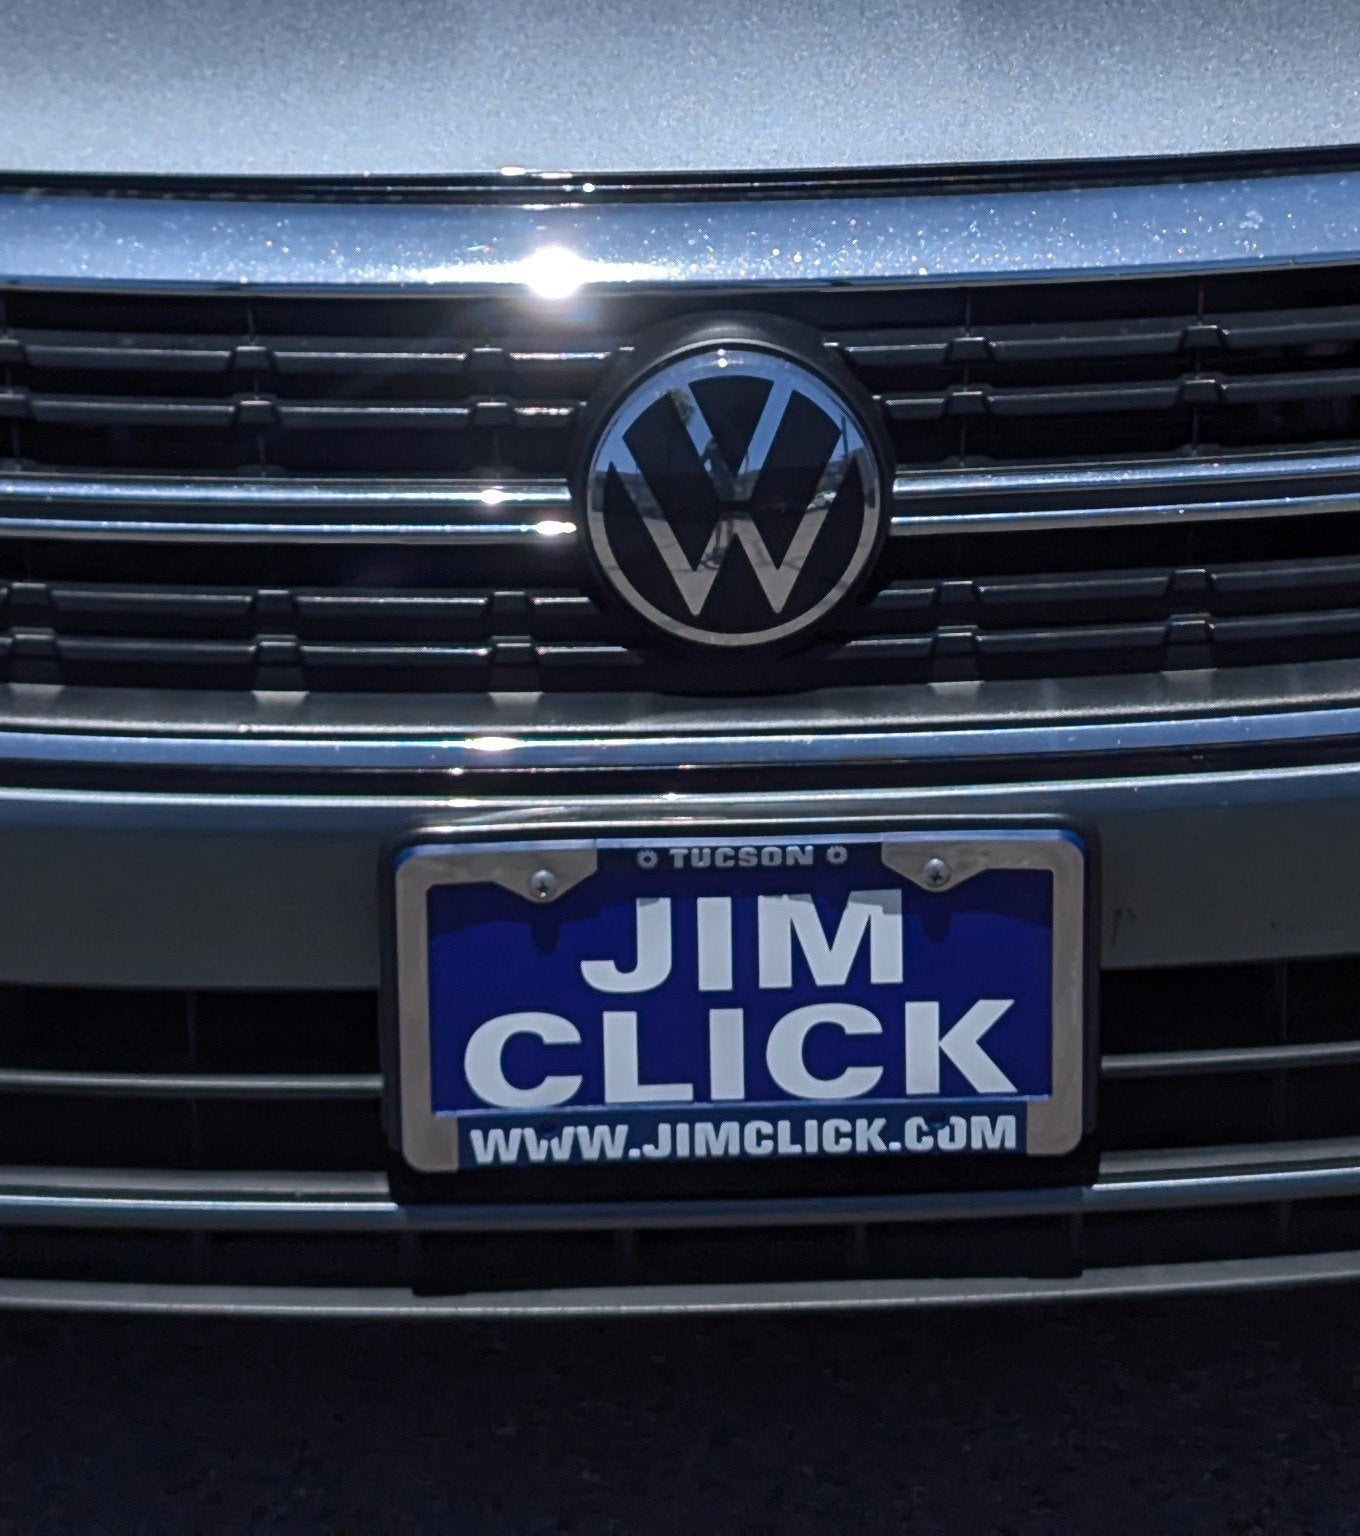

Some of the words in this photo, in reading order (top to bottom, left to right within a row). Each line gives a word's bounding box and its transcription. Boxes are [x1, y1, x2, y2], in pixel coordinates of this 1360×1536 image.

[668, 845, 814, 869] TUCSON
[580, 889, 904, 994] JIM
[463, 998, 1019, 1108] CLICK
[470, 1114, 1017, 1164] WWW.JIMCLICK.COM
